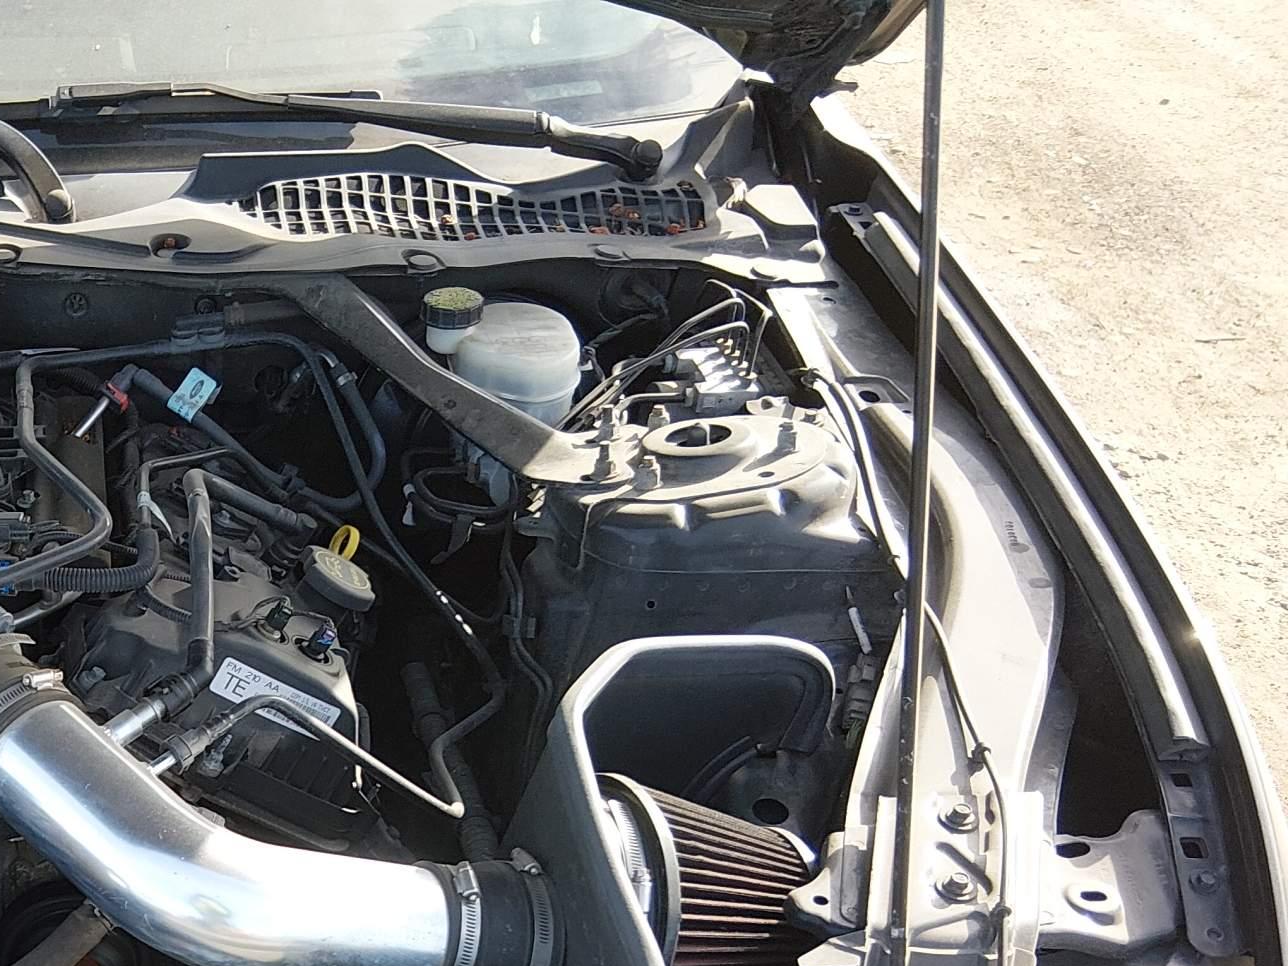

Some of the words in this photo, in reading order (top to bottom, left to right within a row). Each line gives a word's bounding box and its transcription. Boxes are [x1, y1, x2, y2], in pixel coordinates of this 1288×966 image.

[223, 671, 251, 698] TE
[244, 671, 261, 683] 210
[263, 681, 280, 693] AA
